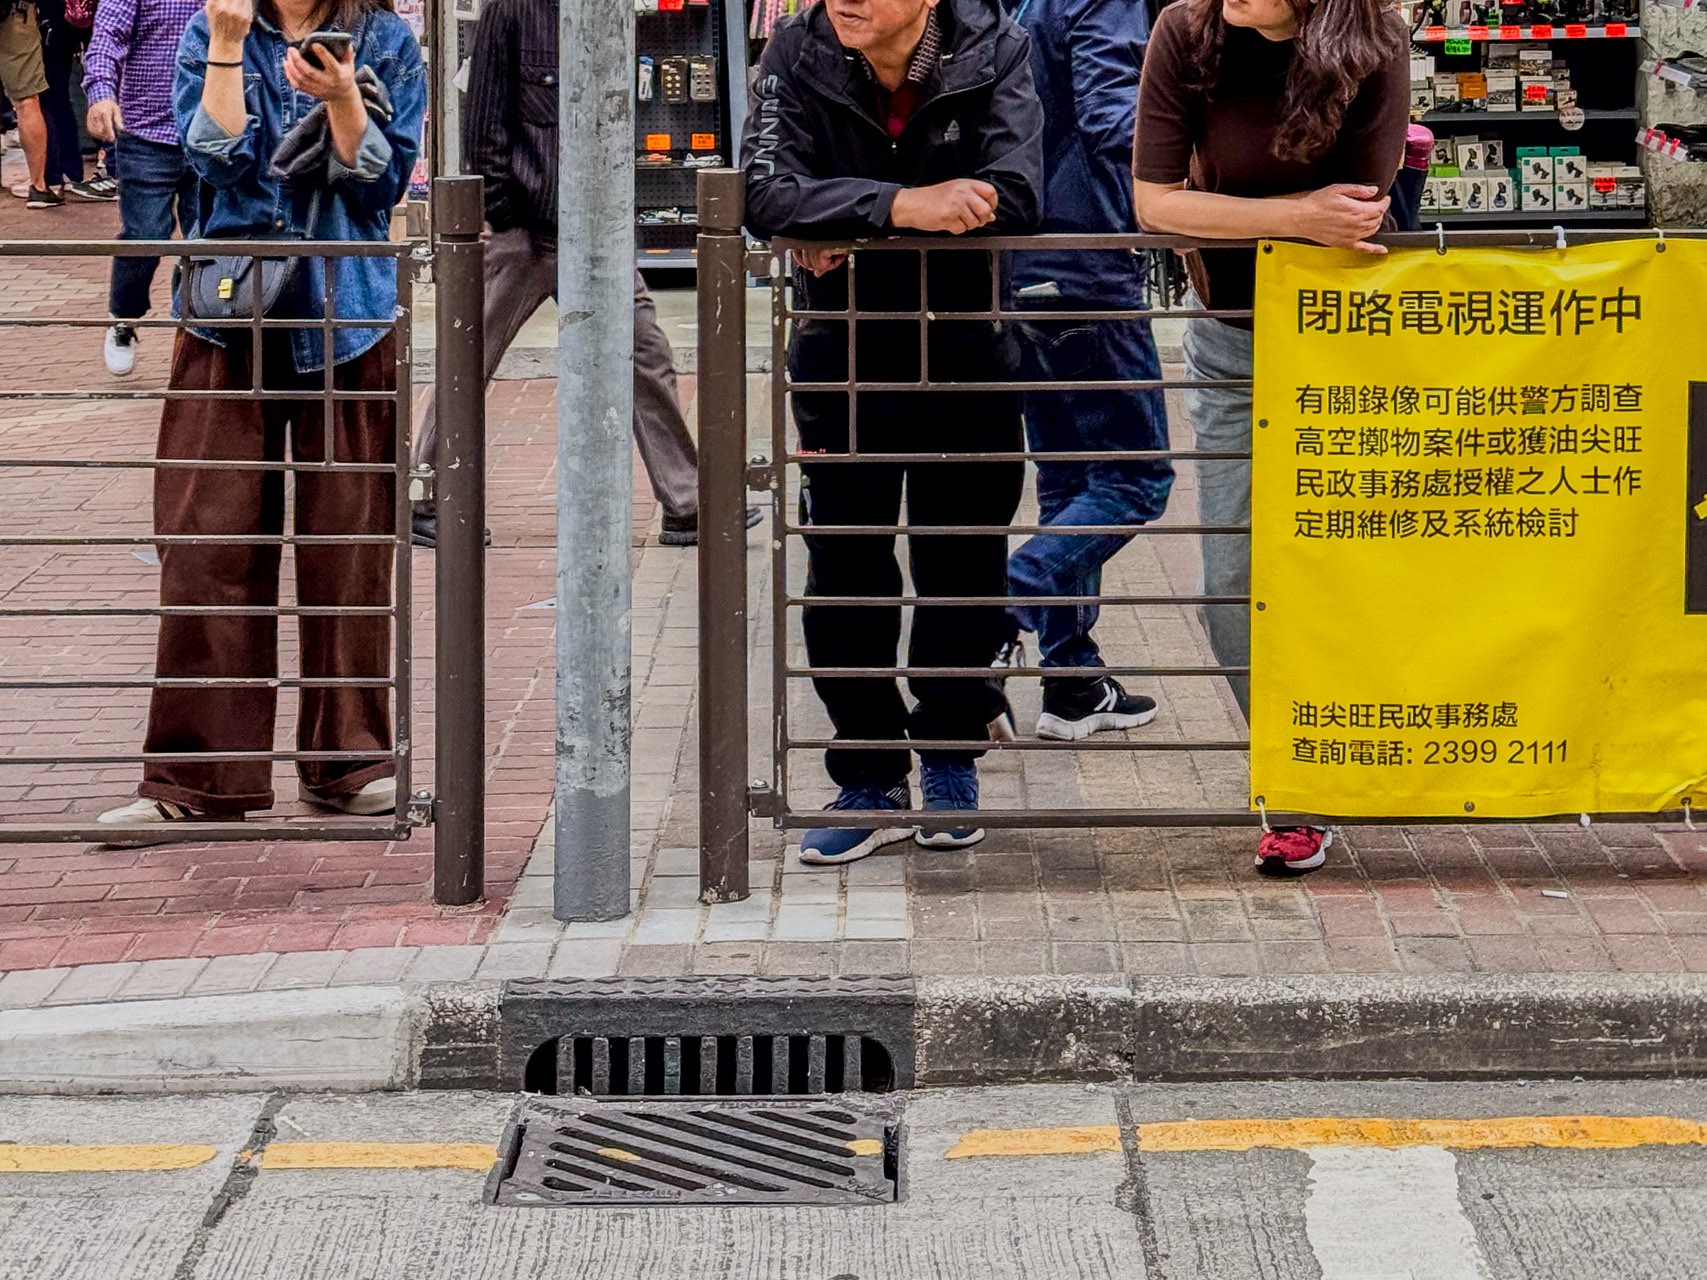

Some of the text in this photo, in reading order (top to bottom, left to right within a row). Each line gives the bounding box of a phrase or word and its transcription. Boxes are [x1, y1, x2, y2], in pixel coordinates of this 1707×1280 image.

[1297, 286, 1641, 337] 閉路電視運作中
[1295, 384, 1643, 416] 有關錄像可能供警方調查
[1294, 426, 1642, 457] 高空擲物案件或獲油尖旺
[1294, 466, 1641, 498] 民政事務處授權之人士作
[1293, 506, 1579, 539] 定期維修及系統檢討
[1291, 700, 1518, 730] 油尖旺民政事務處
[1291, 738, 1568, 766] 查詢電話: 2399 2111
